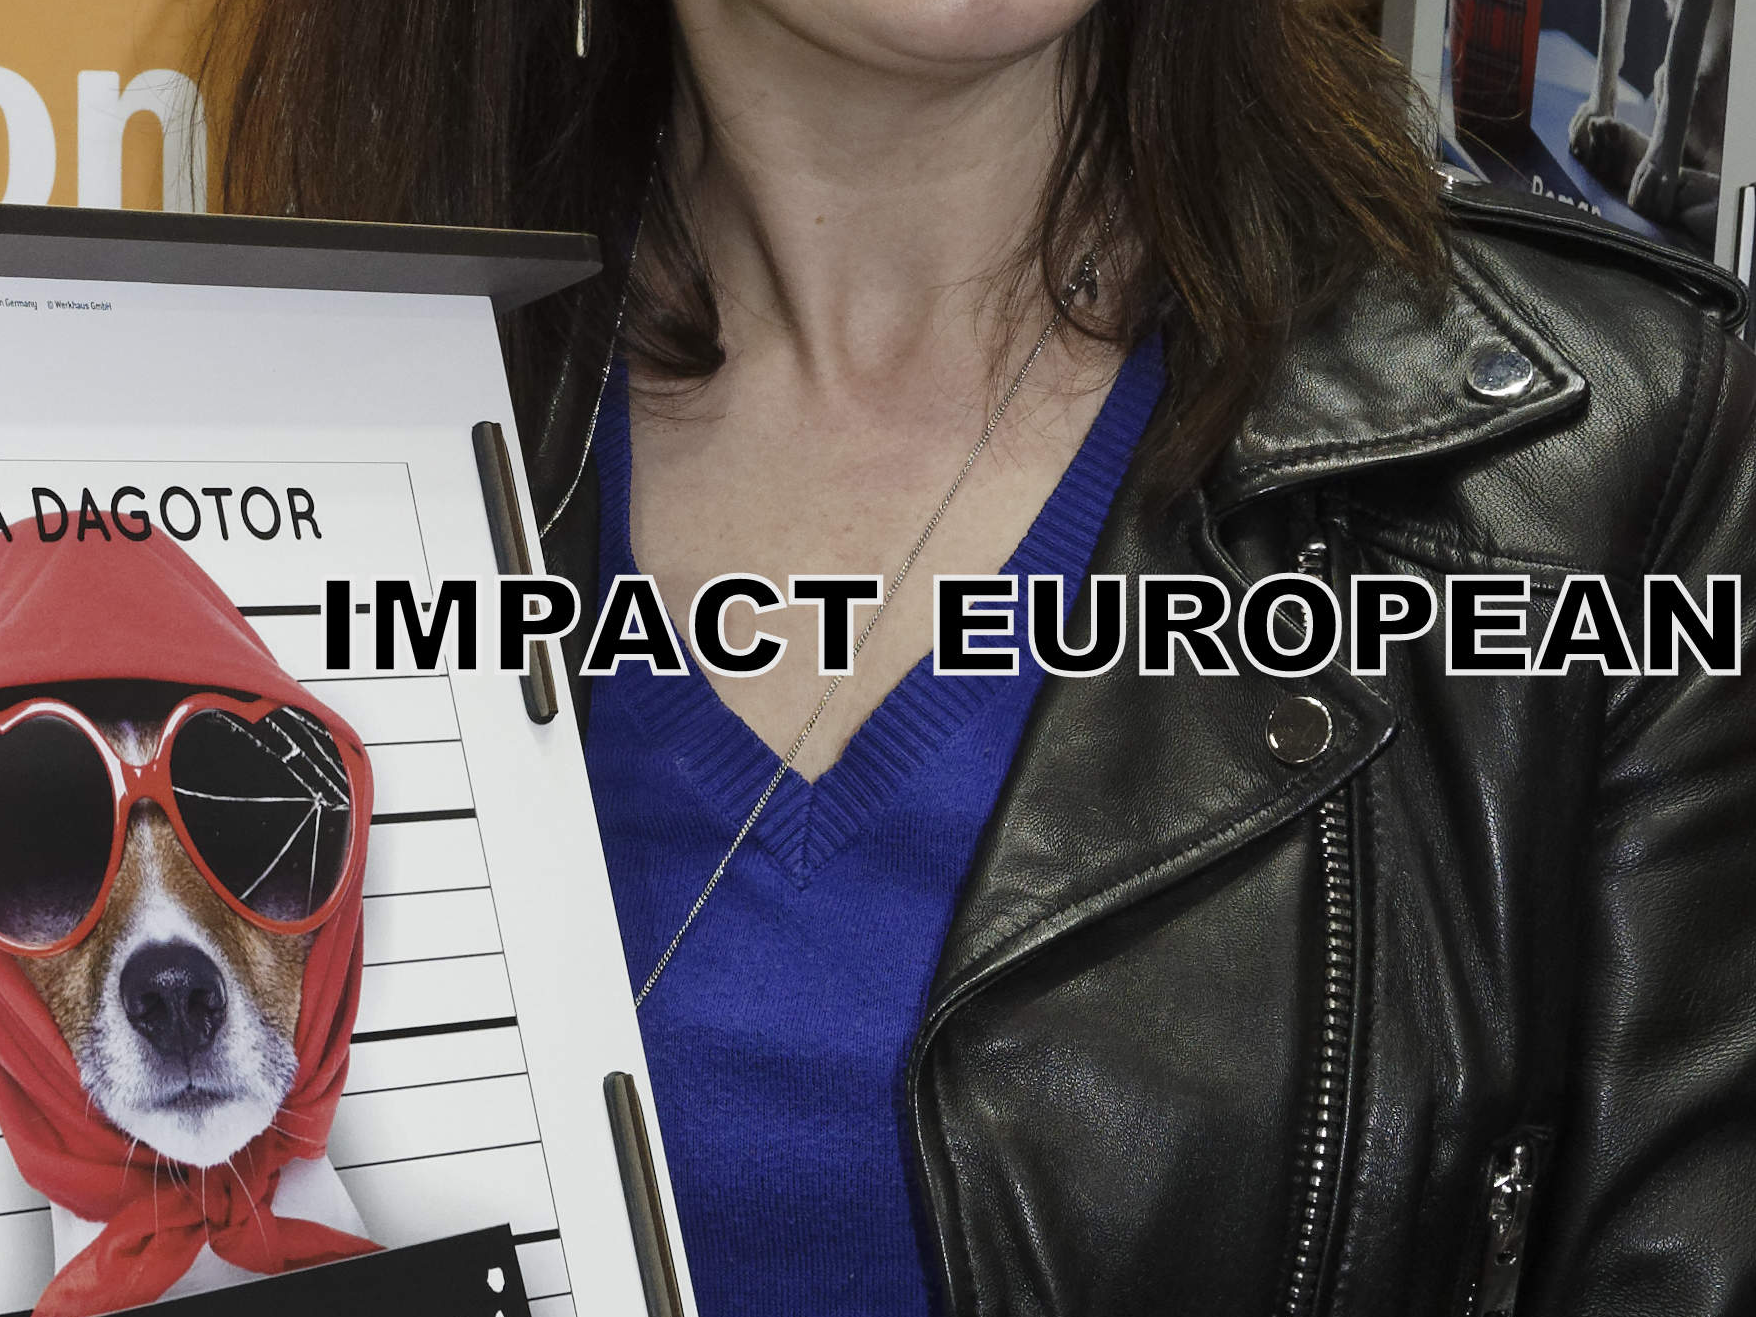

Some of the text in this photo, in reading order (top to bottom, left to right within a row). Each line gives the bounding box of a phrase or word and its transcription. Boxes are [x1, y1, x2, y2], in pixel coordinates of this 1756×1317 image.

[5, 298, 38, 310] Germany
[55, 300, 90, 310] Werkhaus
[31, 486, 323, 542] DAGOTOR
